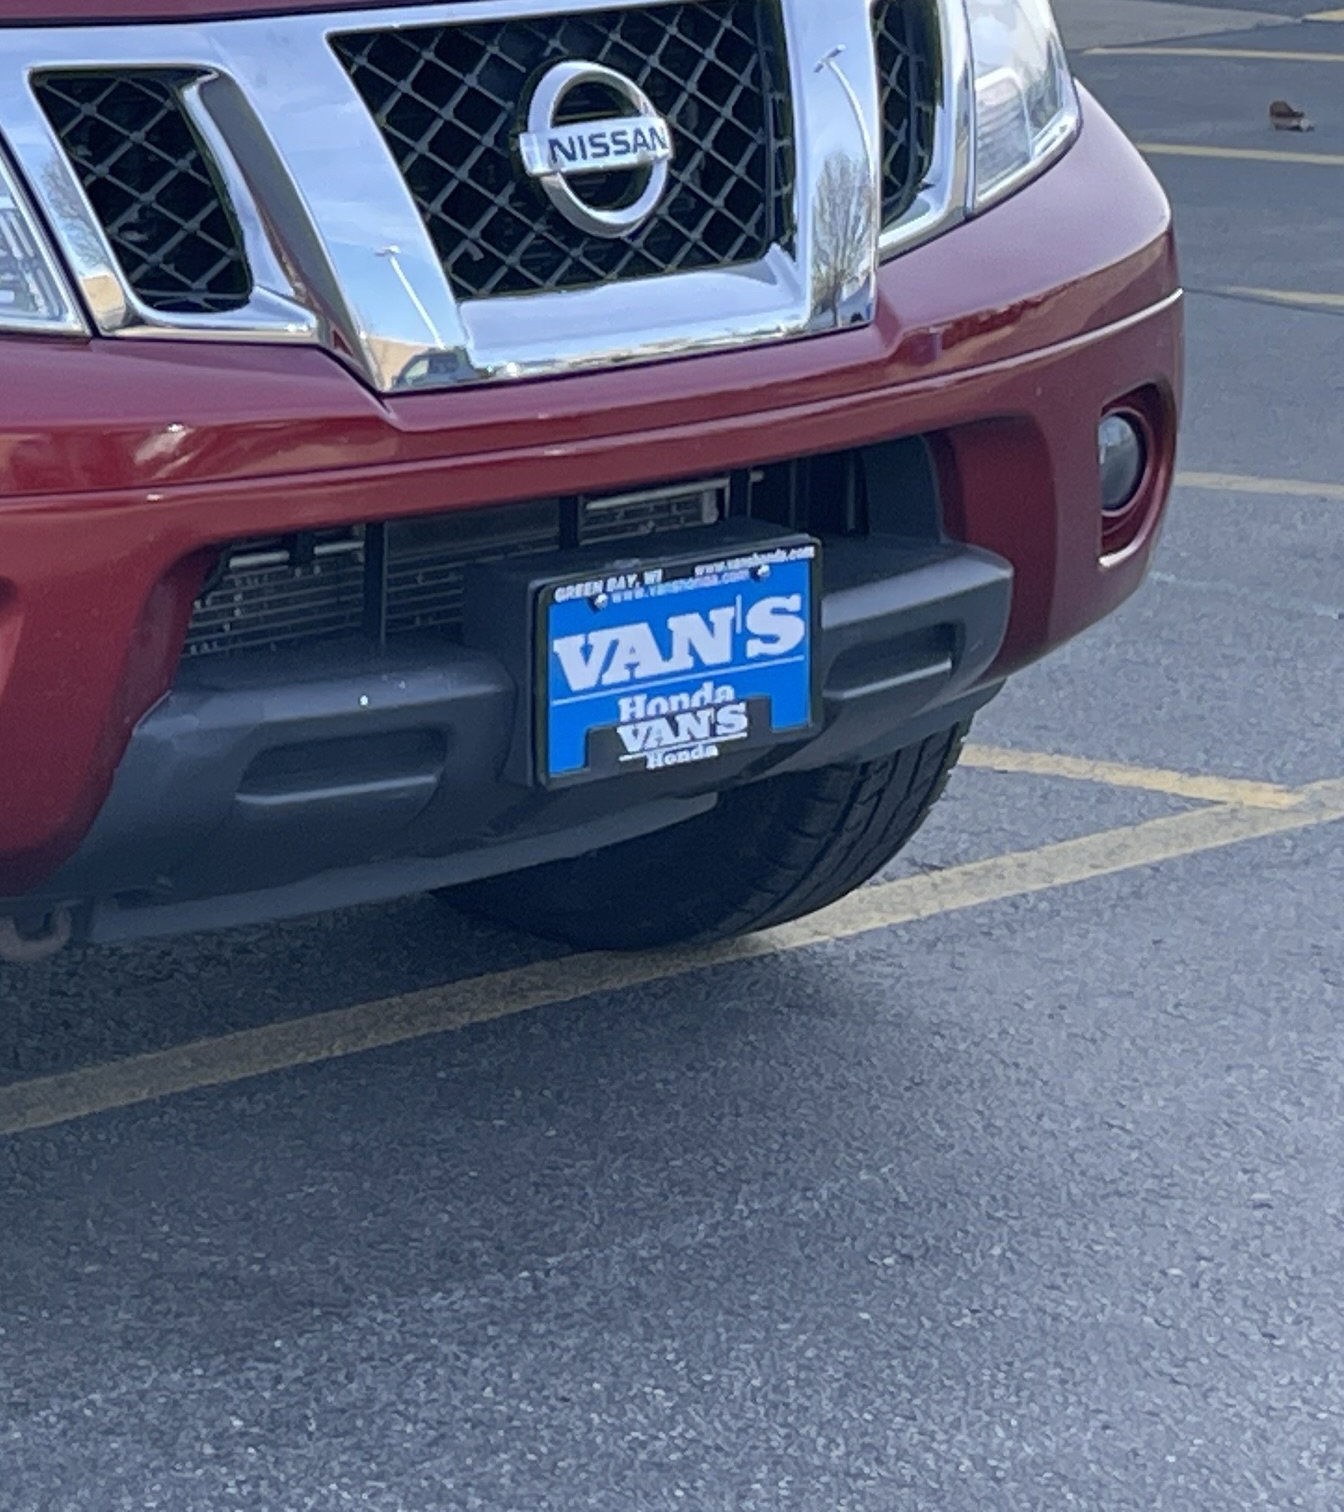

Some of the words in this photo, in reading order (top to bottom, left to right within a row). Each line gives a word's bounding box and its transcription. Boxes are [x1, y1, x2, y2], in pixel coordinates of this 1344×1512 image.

[548, 126, 669, 163] NISSAN
[554, 579, 604, 603] GREEN
[643, 568, 663, 585] WI
[553, 593, 806, 693] VAN'S
[618, 680, 735, 723] Honda
[616, 702, 748, 754] VAN'S
[645, 743, 720, 770] Honda
